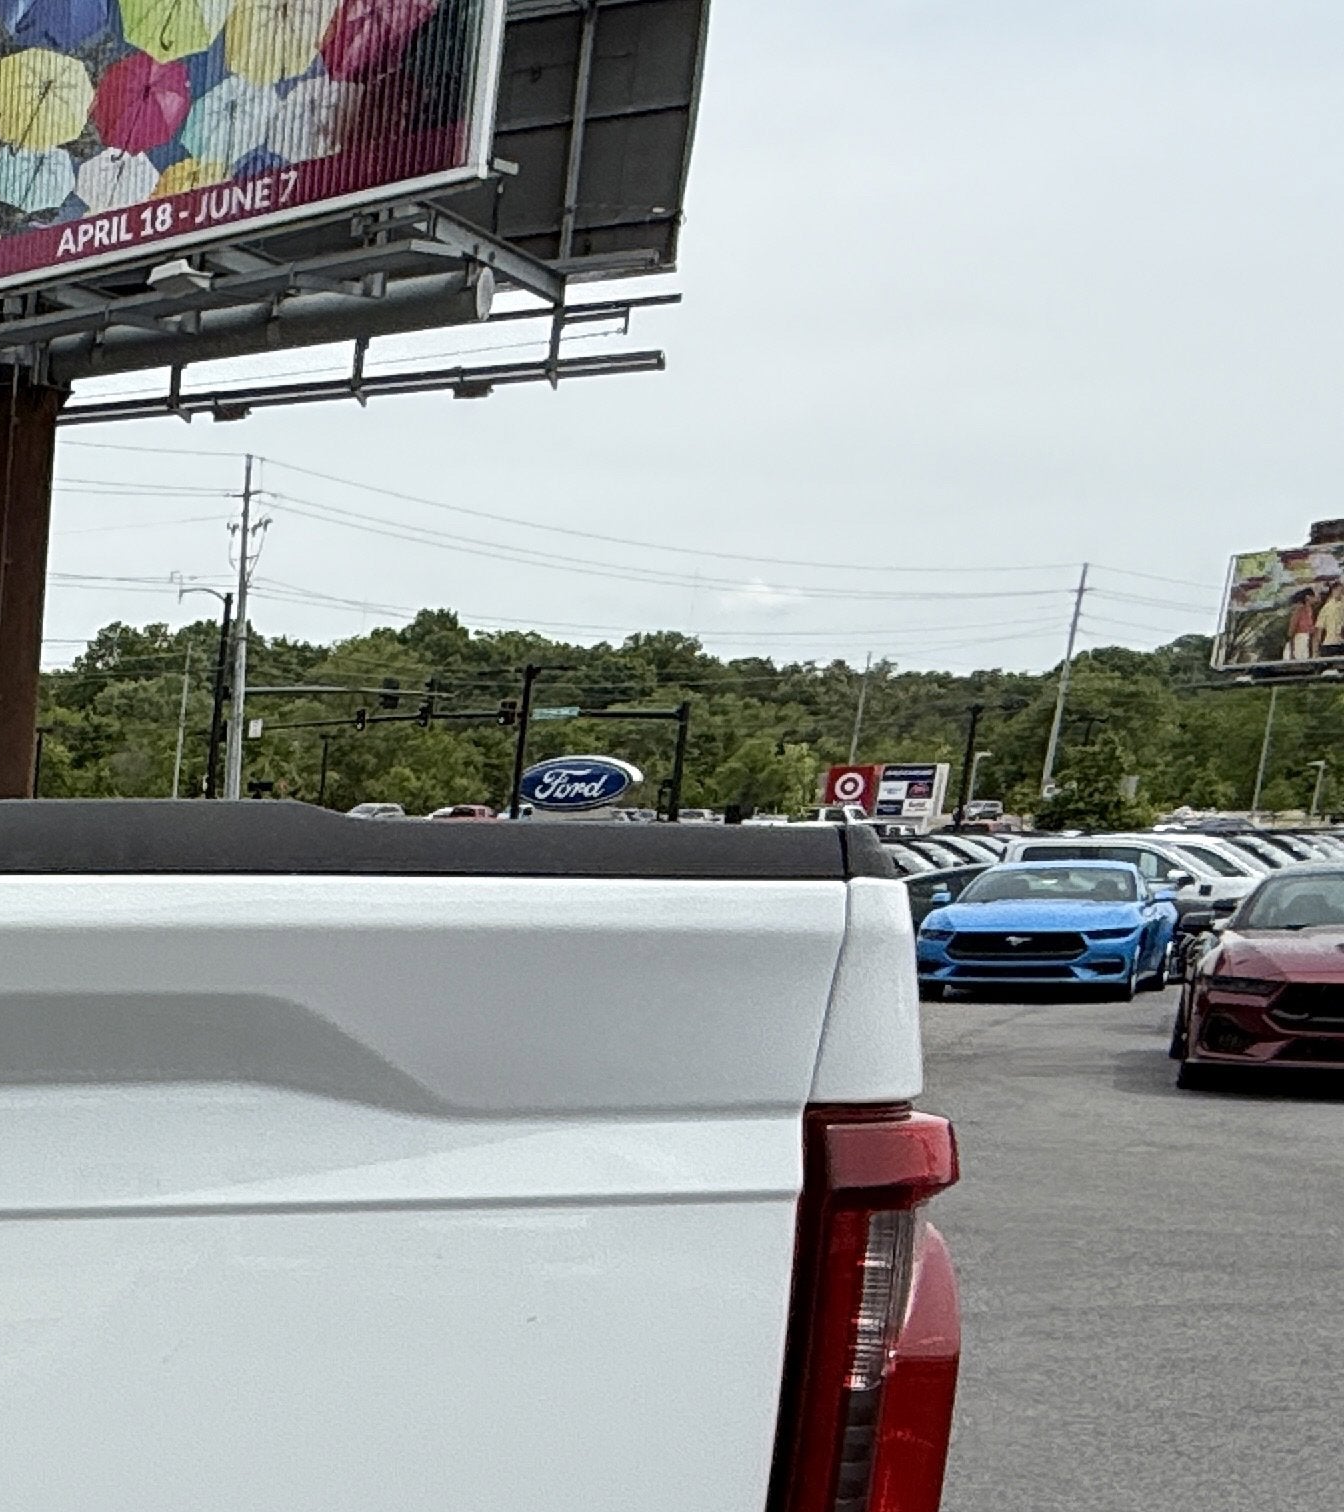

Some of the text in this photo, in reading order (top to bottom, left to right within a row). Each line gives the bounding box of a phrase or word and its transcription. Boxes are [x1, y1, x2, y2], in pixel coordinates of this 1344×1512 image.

[56, 213, 133, 258] APRIL
[140, 203, 173, 237] 18
[195, 177, 273, 224] JUNE
[280, 170, 298, 203] 7
[534, 769, 608, 800] Ford
